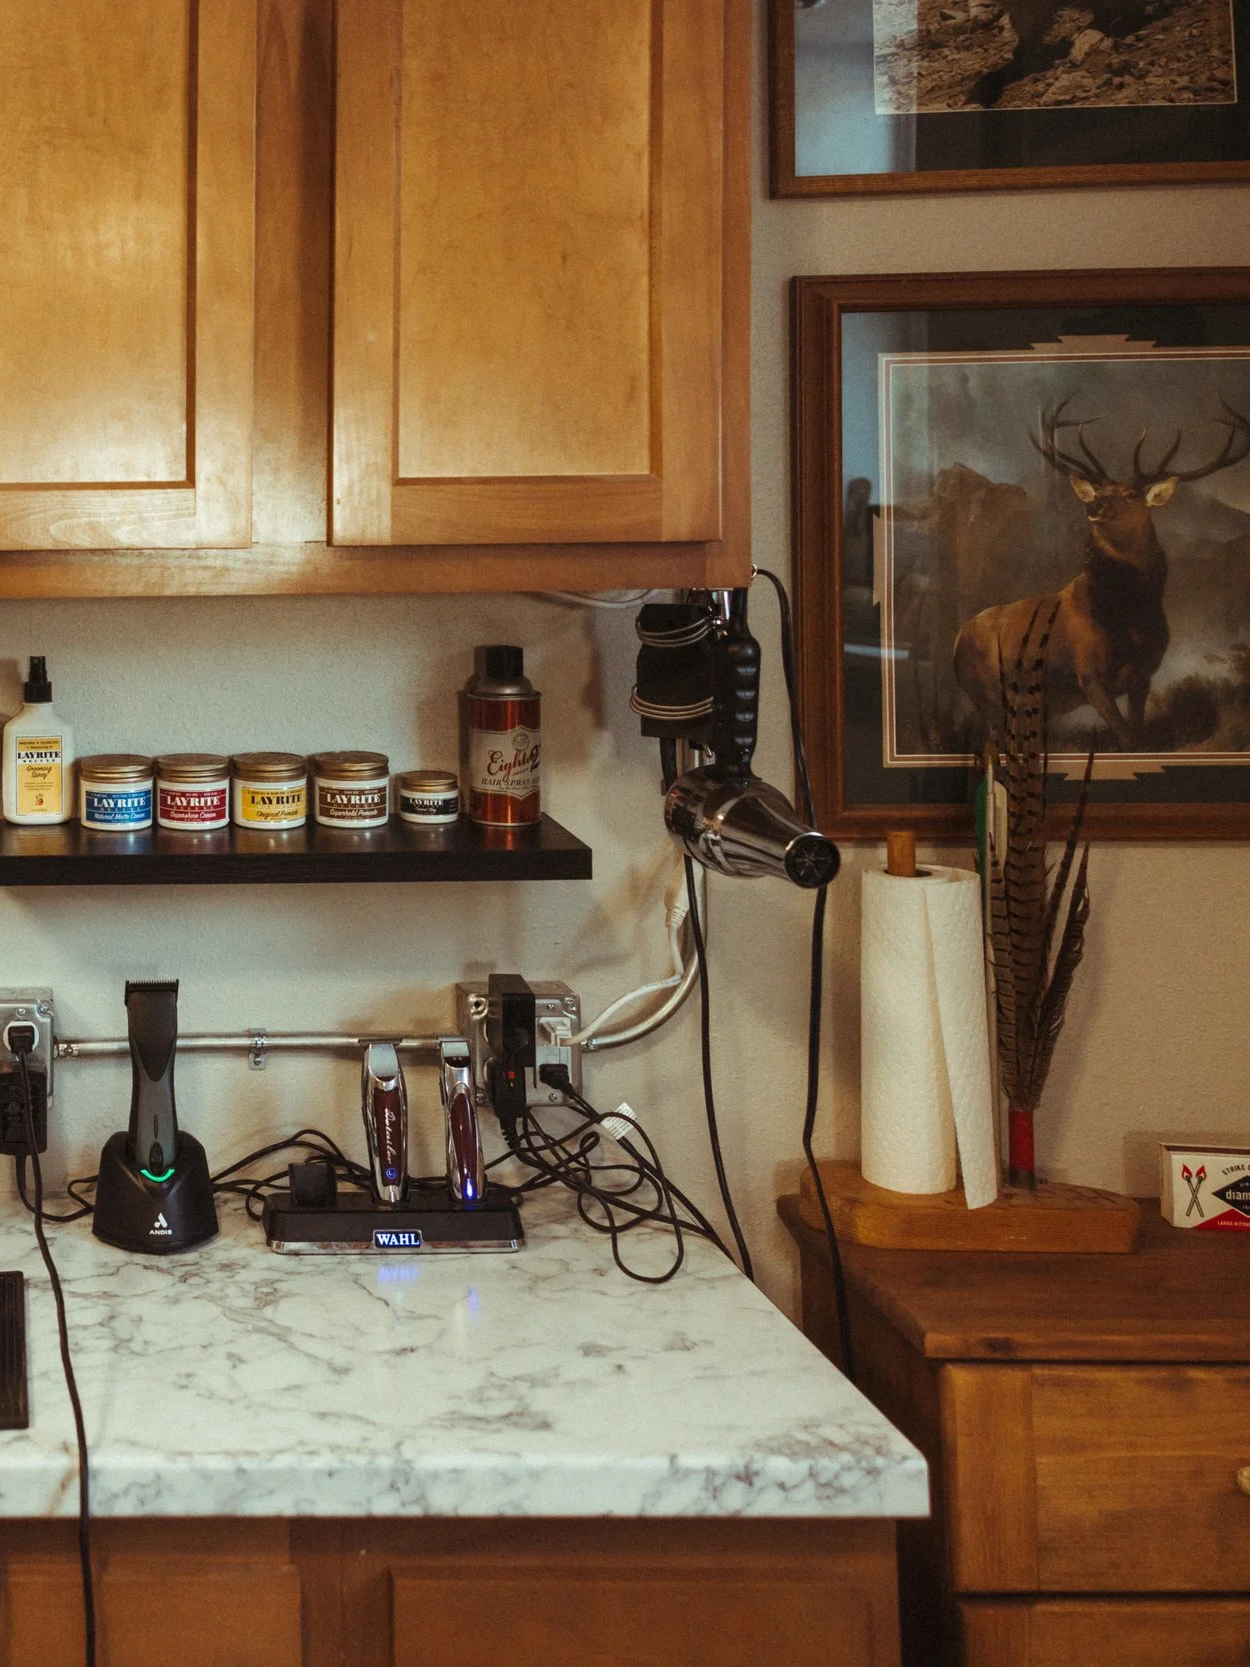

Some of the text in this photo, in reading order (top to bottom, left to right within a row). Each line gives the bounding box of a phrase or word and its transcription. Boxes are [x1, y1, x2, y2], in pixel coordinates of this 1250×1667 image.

[18, 751, 60, 759] LAYRITE
[27, 765, 52, 774] Grooming
[30, 772, 48, 780] Spray
[93, 797, 146, 807] LAYRITE
[167, 796, 220, 806] LAYRITE
[251, 794, 303, 805] LAYRITE
[327, 794, 380, 804] LAYRITE
[256, 810, 279, 820] Original
[384, 1108, 396, 1164] Detailer
[1222, 1164, 1245, 1175] STRIKE
[376, 1234, 420, 1245] WAHL
